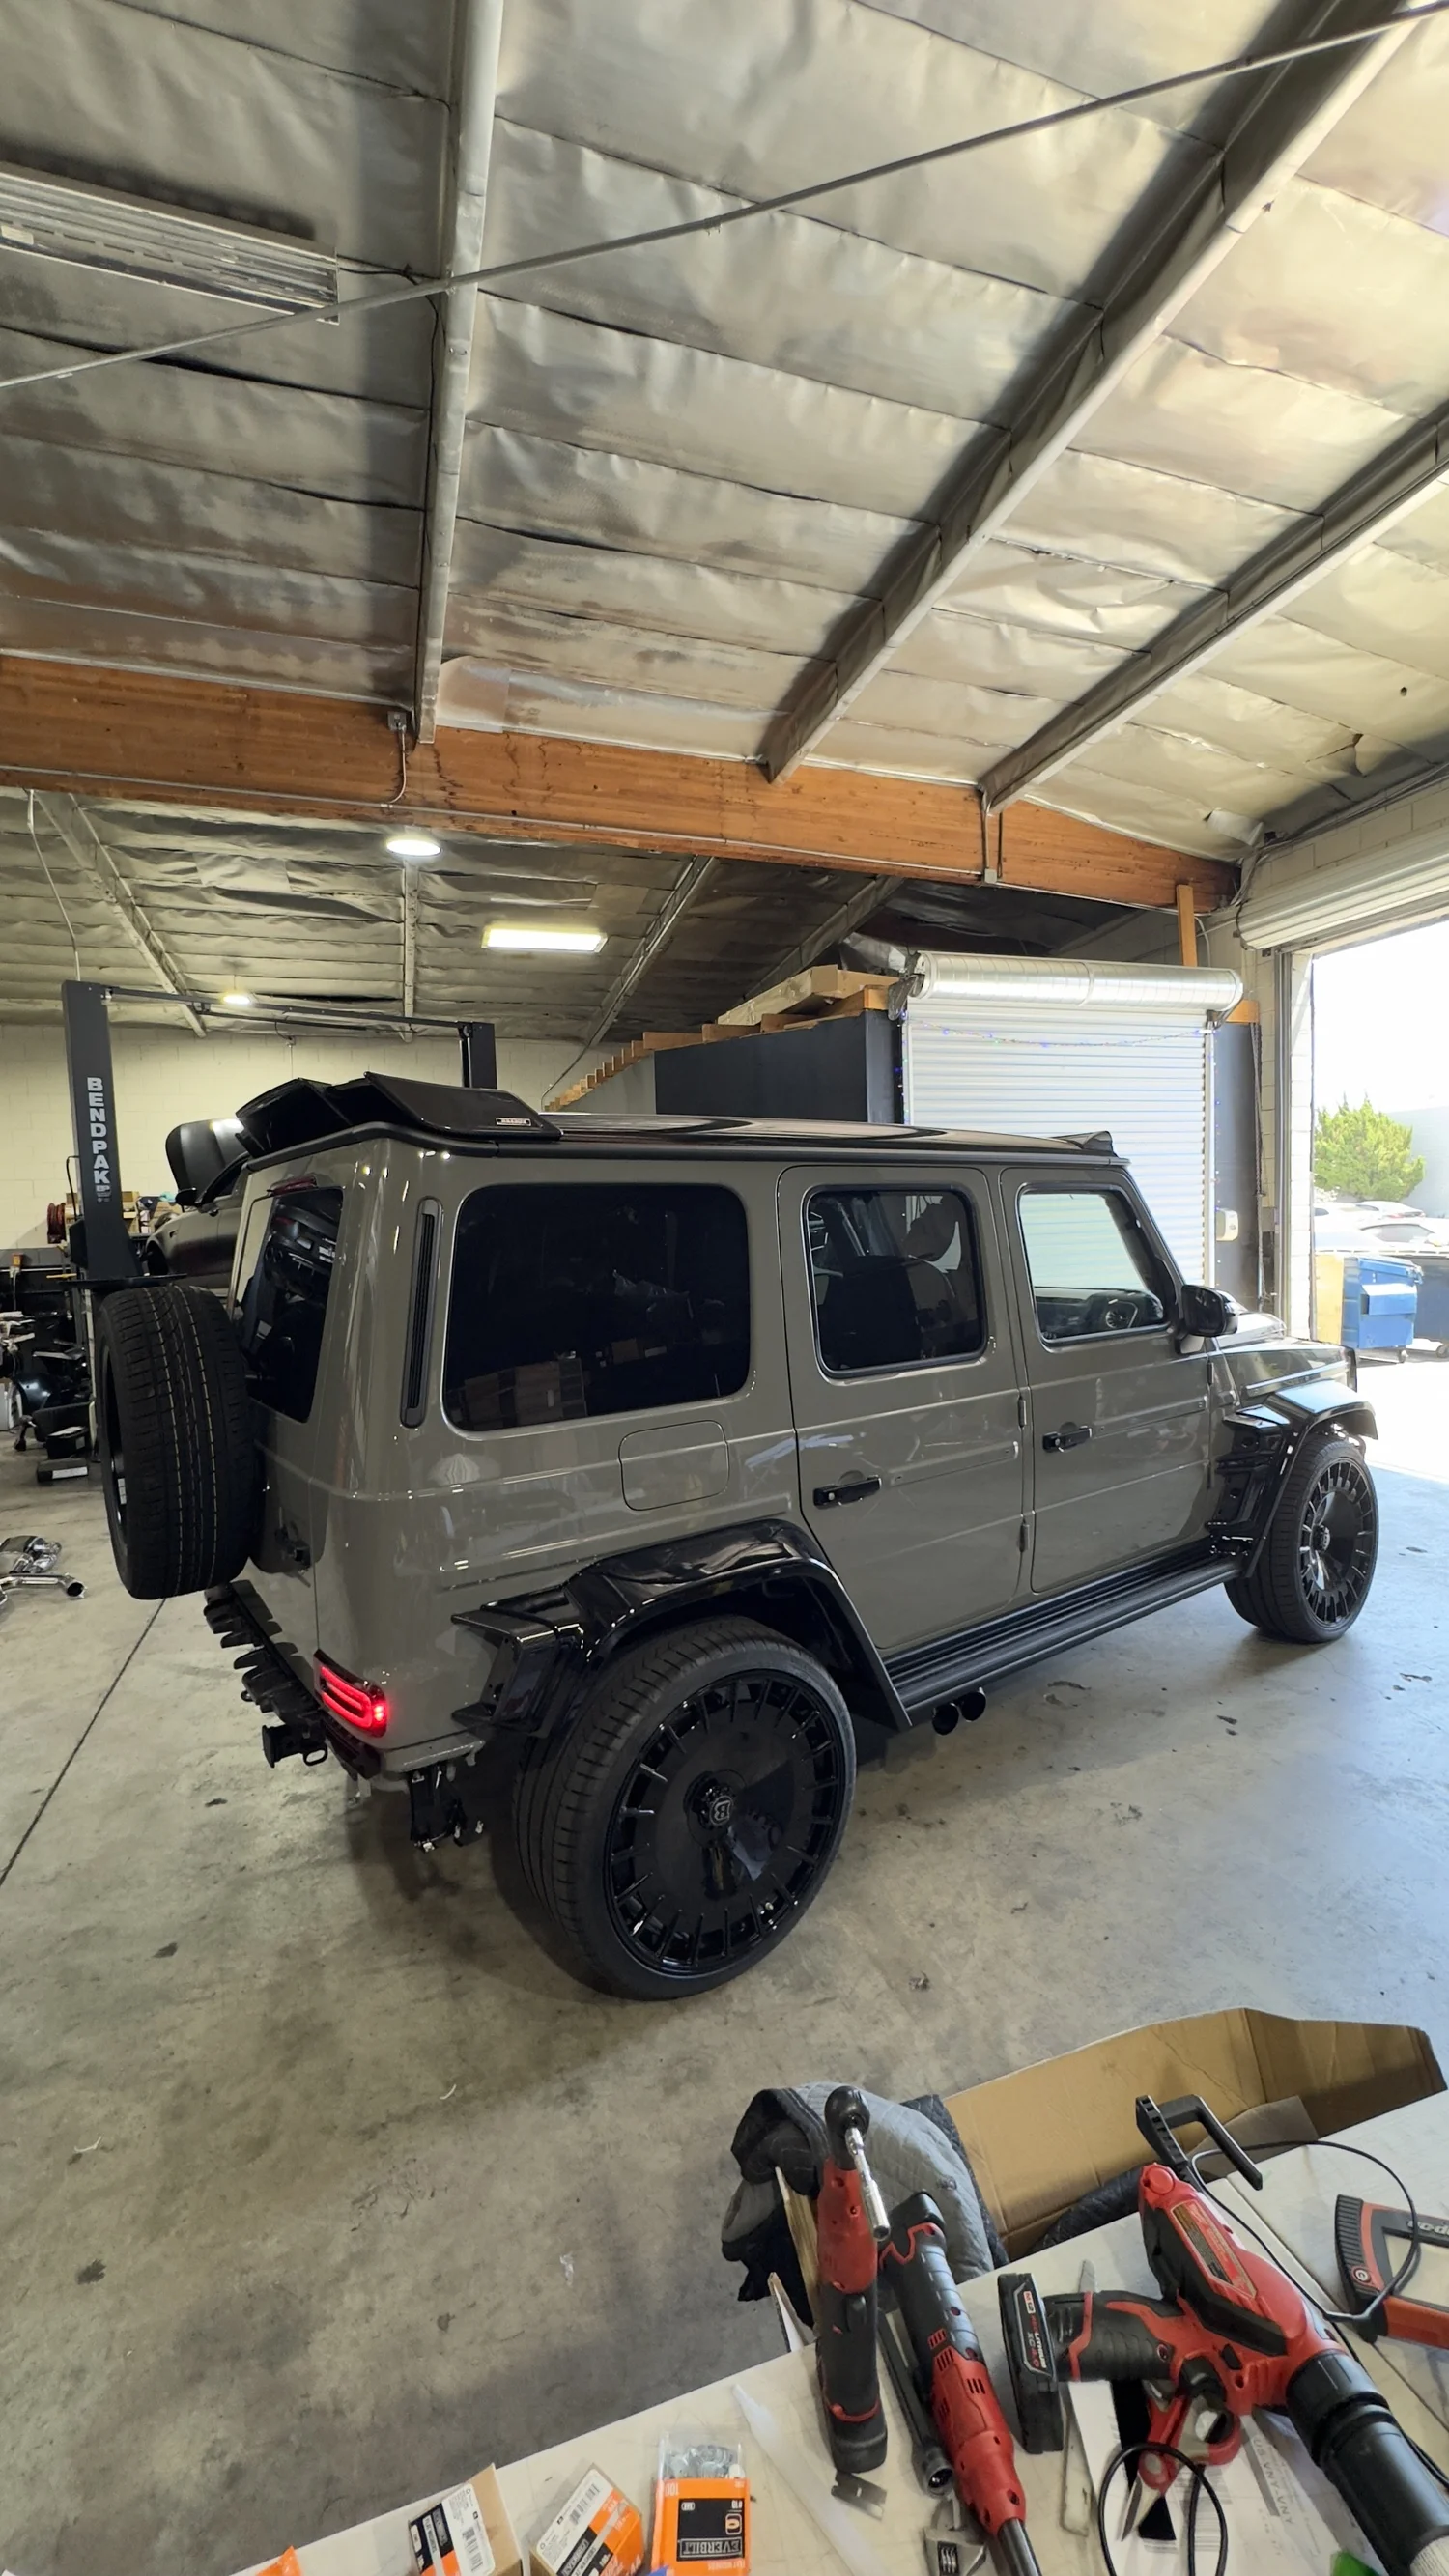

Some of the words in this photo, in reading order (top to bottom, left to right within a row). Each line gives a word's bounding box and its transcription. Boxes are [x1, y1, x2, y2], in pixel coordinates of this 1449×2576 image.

[87, 1077, 111, 1184] BENDPAK
[1024, 2291, 1036, 2313] M12
[683, 2540, 740, 2555] EVERBILT
